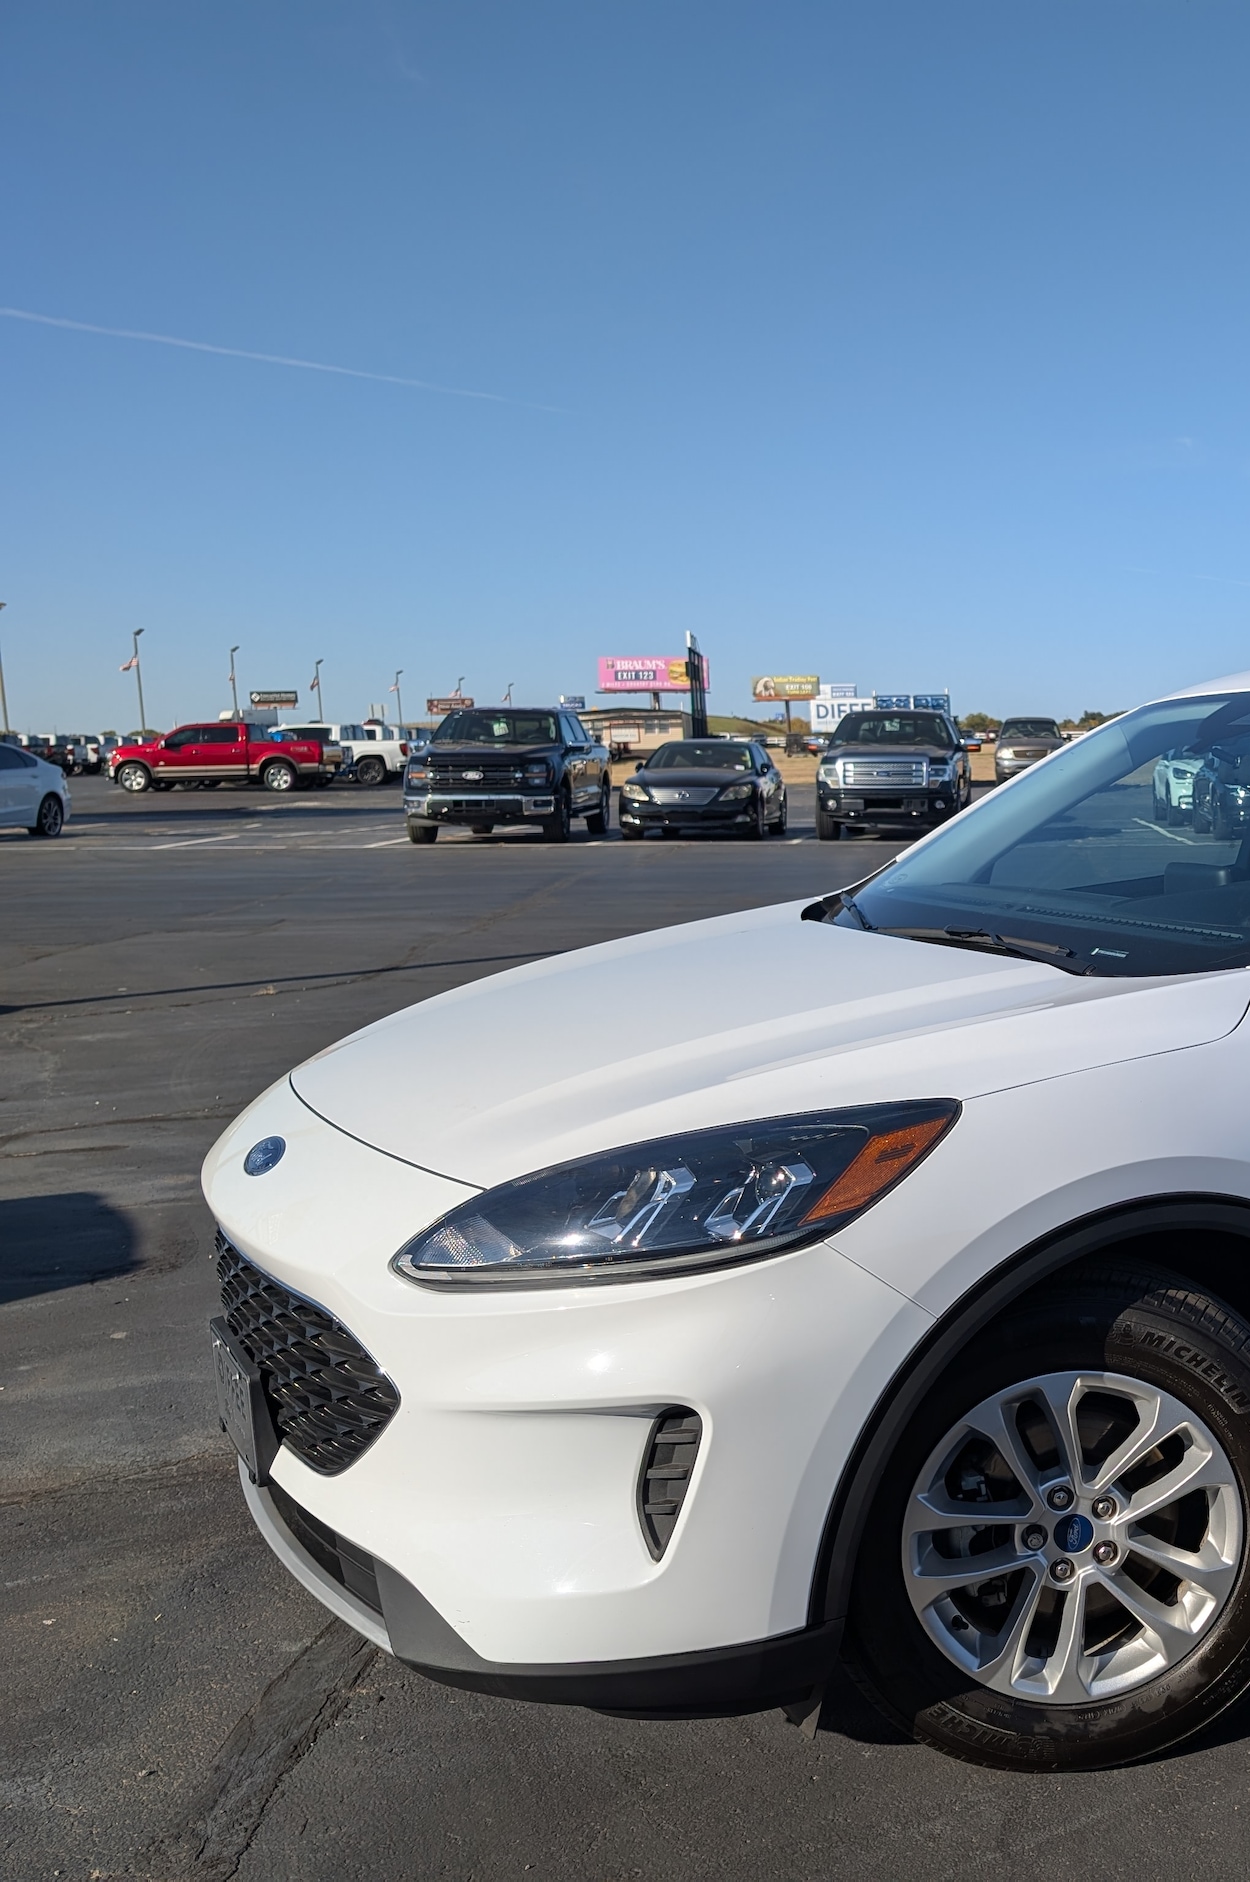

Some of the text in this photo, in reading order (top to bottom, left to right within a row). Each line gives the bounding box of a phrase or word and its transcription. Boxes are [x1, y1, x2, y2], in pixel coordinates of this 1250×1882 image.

[615, 659, 667, 670] BRAUM'S
[617, 671, 654, 681] EXIT 123
[1069, 1523, 1080, 1545] Ford
